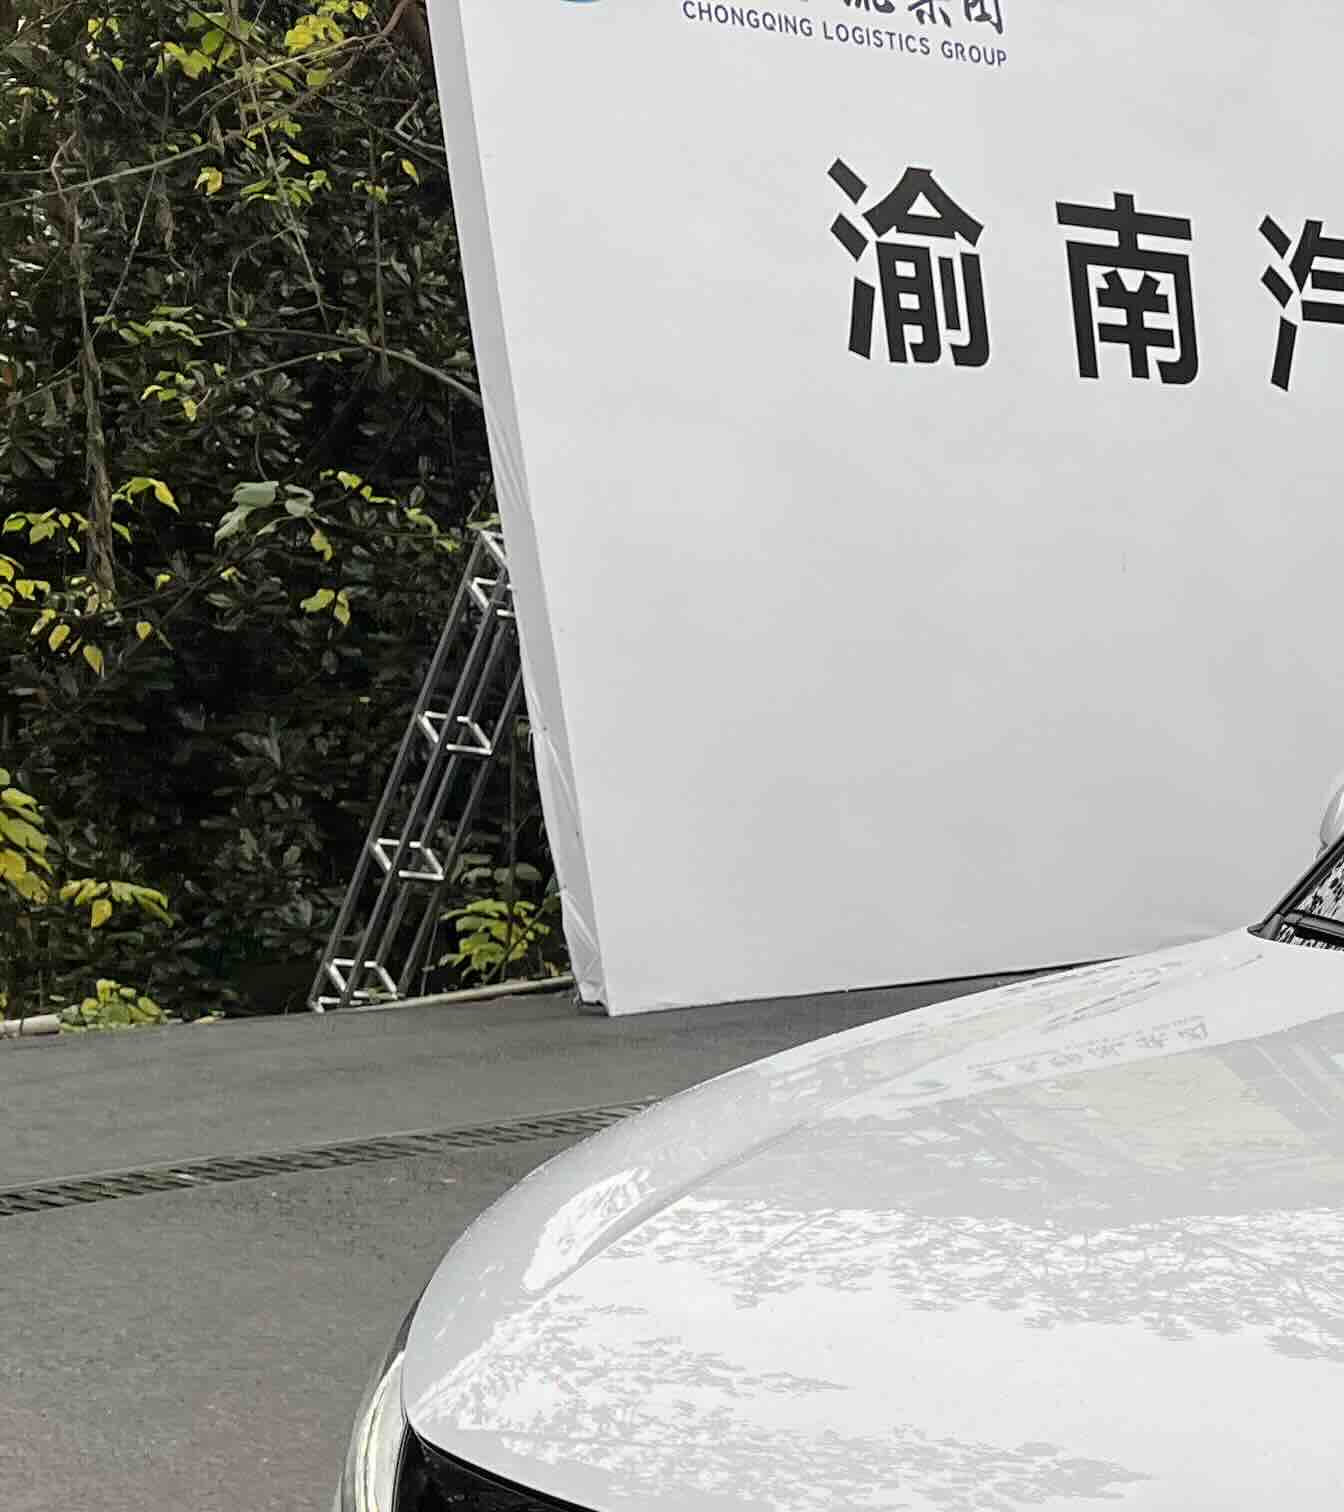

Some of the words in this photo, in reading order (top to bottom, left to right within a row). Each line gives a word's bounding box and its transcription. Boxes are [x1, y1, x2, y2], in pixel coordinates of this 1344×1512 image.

[682, 1, 814, 38] CHONGQING
[822, 20, 930, 56] LOGISTICS
[940, 40, 1008, 68] GROUP
